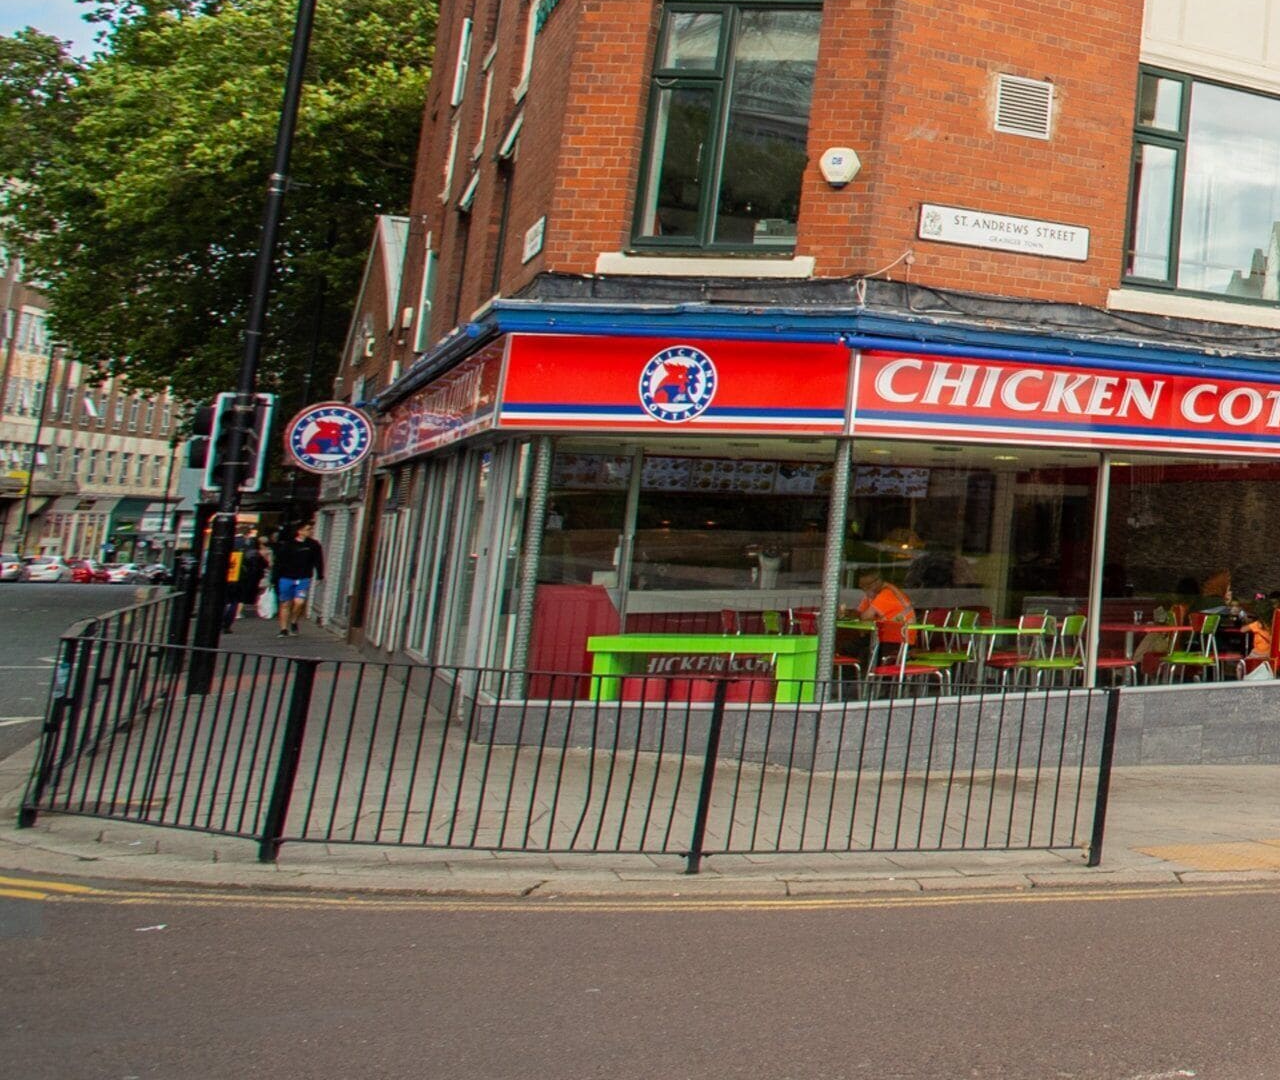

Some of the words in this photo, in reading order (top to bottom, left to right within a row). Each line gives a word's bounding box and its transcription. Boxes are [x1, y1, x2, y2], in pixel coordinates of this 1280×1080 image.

[972, 218, 1029, 236] ANDREWS
[1036, 227, 1077, 243] STREET
[1024, 240, 1045, 250] TOWN
[874, 358, 1165, 421] CHICKEN
